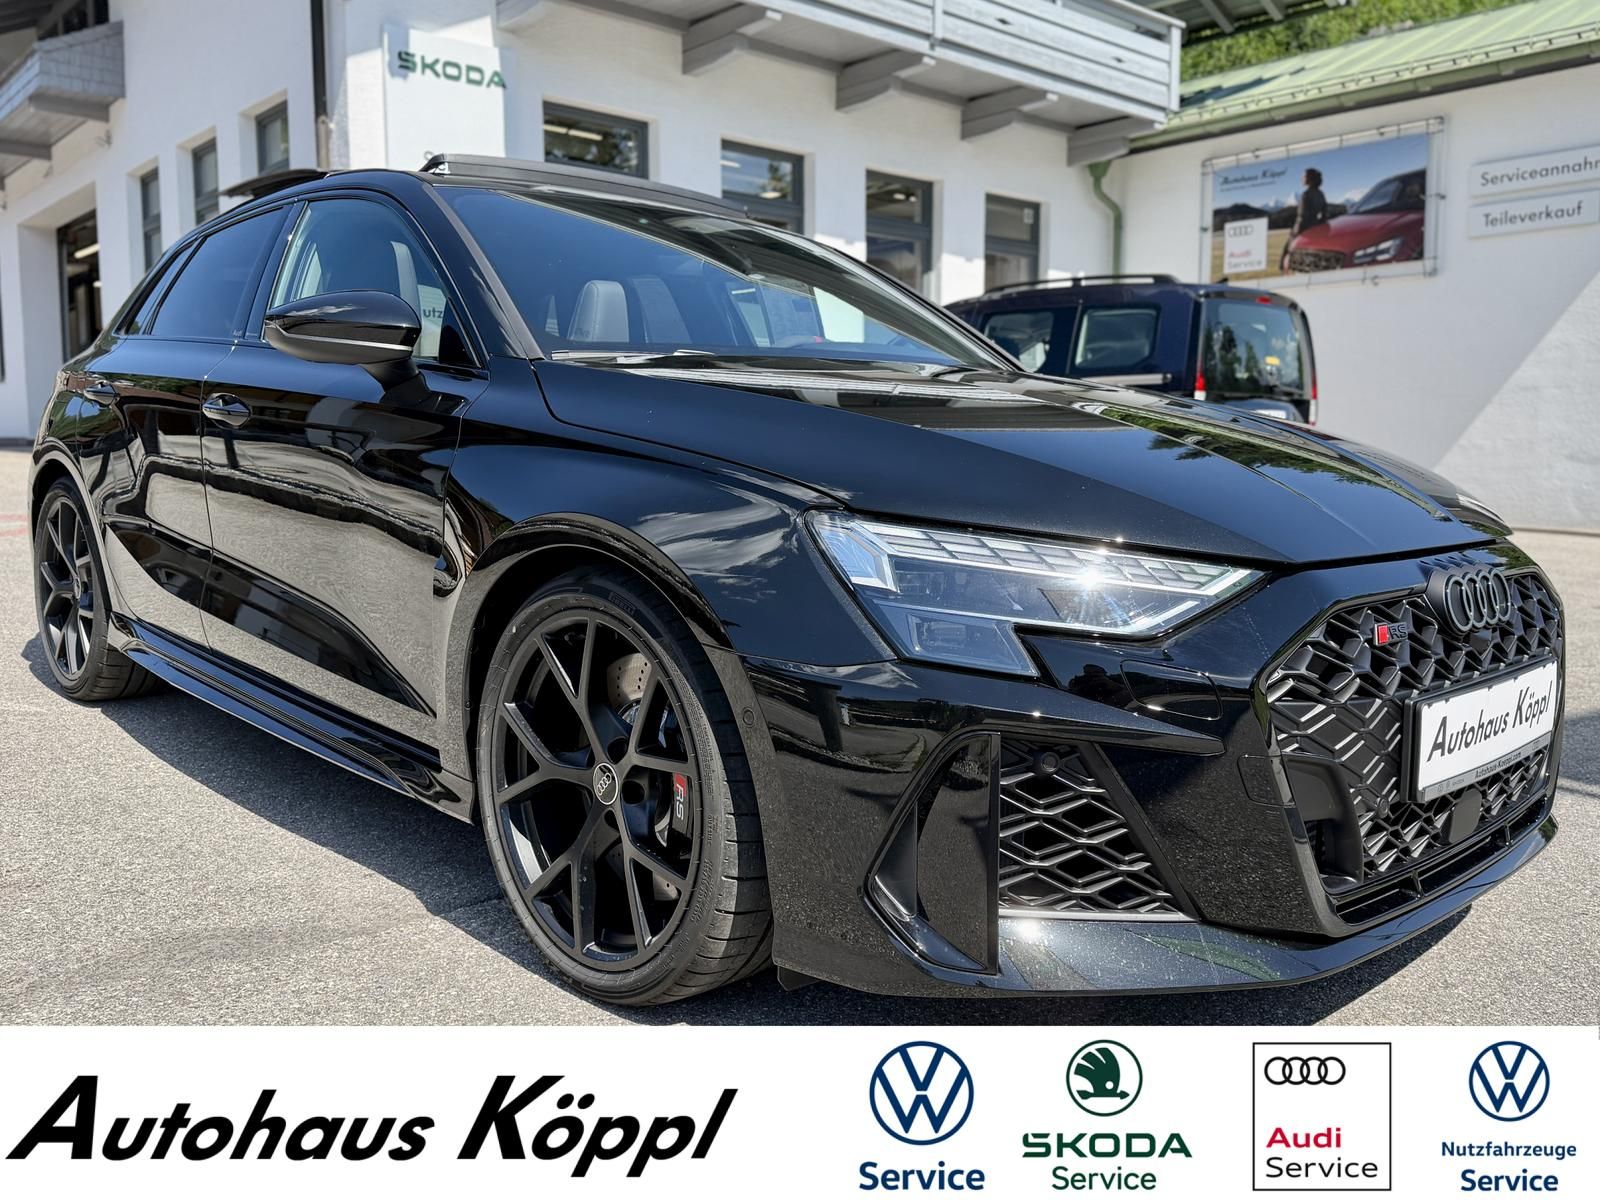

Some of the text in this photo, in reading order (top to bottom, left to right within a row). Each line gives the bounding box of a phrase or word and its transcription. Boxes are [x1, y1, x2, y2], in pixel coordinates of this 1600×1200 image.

[1482, 200, 1584, 227] Teileverkauf
[1427, 680, 1553, 763] Autohaus Köppl
[676, 783, 684, 821] RS
